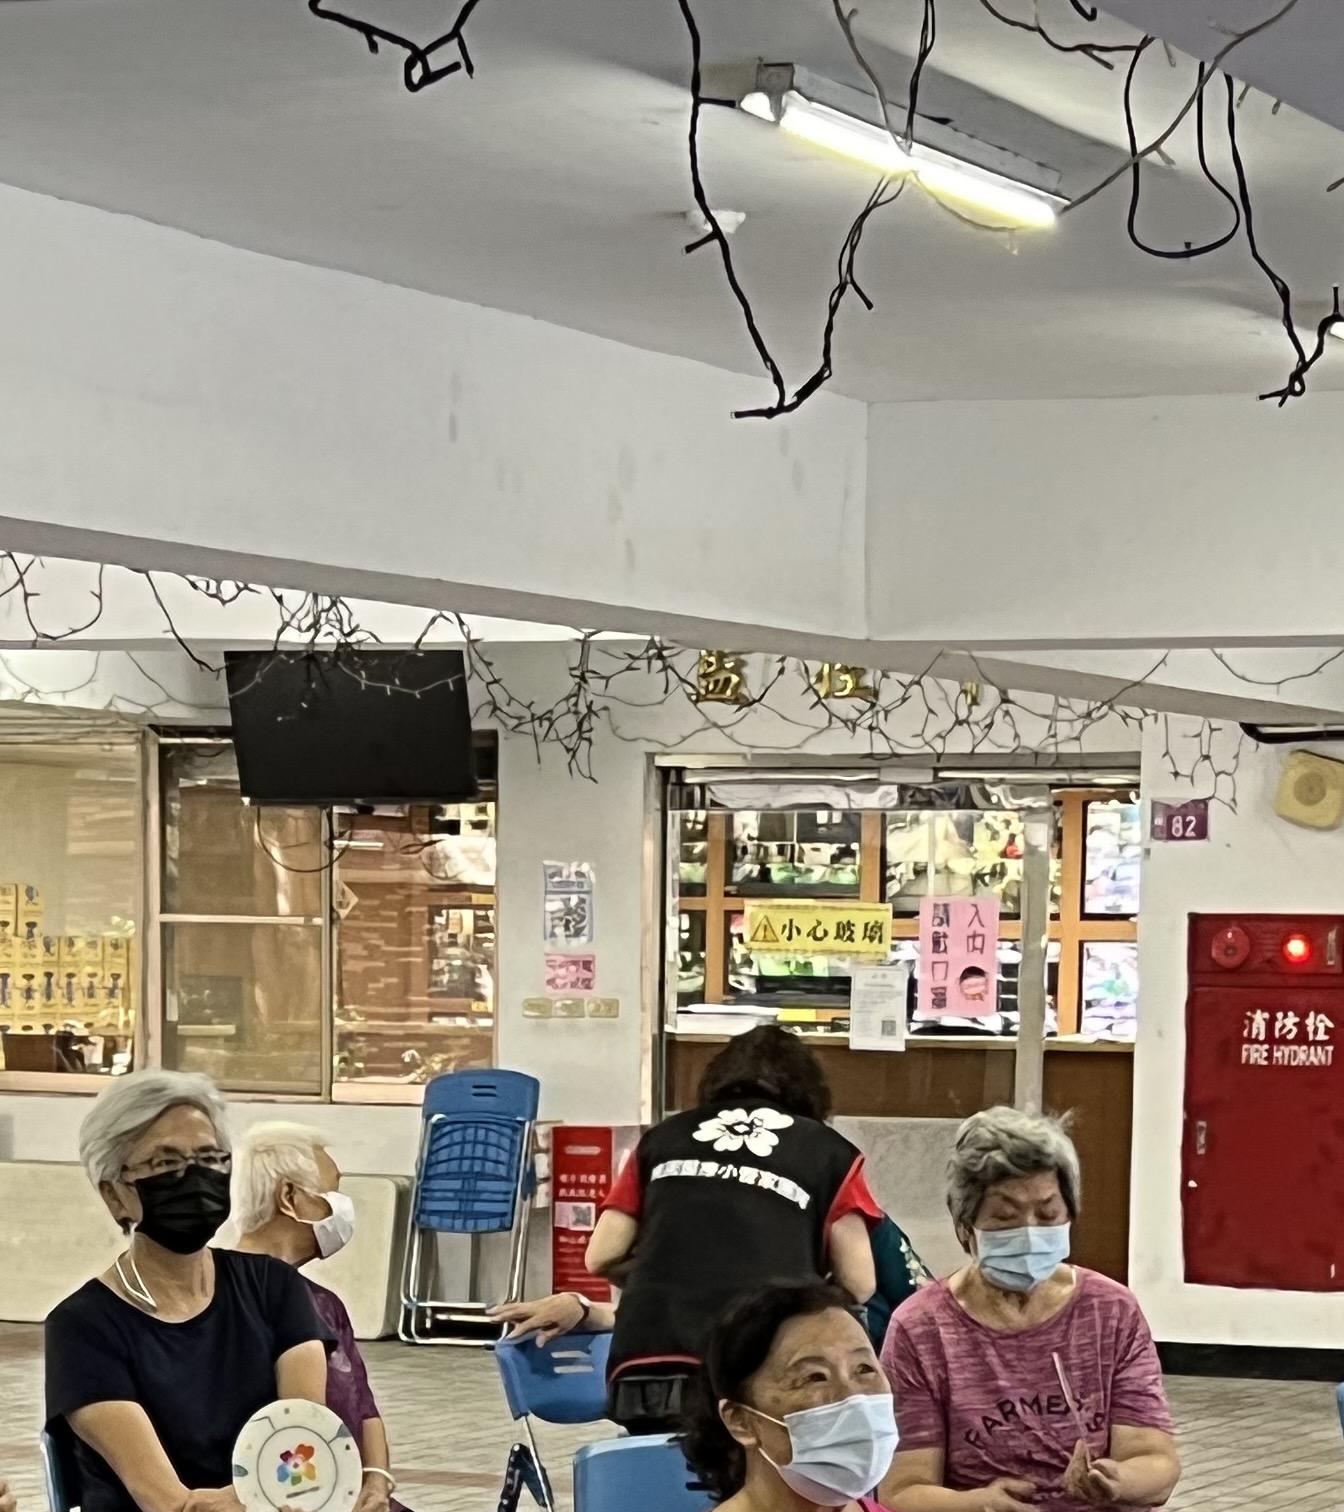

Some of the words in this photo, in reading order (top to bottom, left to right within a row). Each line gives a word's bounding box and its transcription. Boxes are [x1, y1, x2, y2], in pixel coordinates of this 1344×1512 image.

[1171, 815, 1197, 837] 82
[781, 917, 885, 945] 小心玻璃
[1242, 1009, 1335, 1041] 消防栓
[1241, 1043, 1270, 1066] FIRE
[1272, 1044, 1334, 1067] HYDRANT
